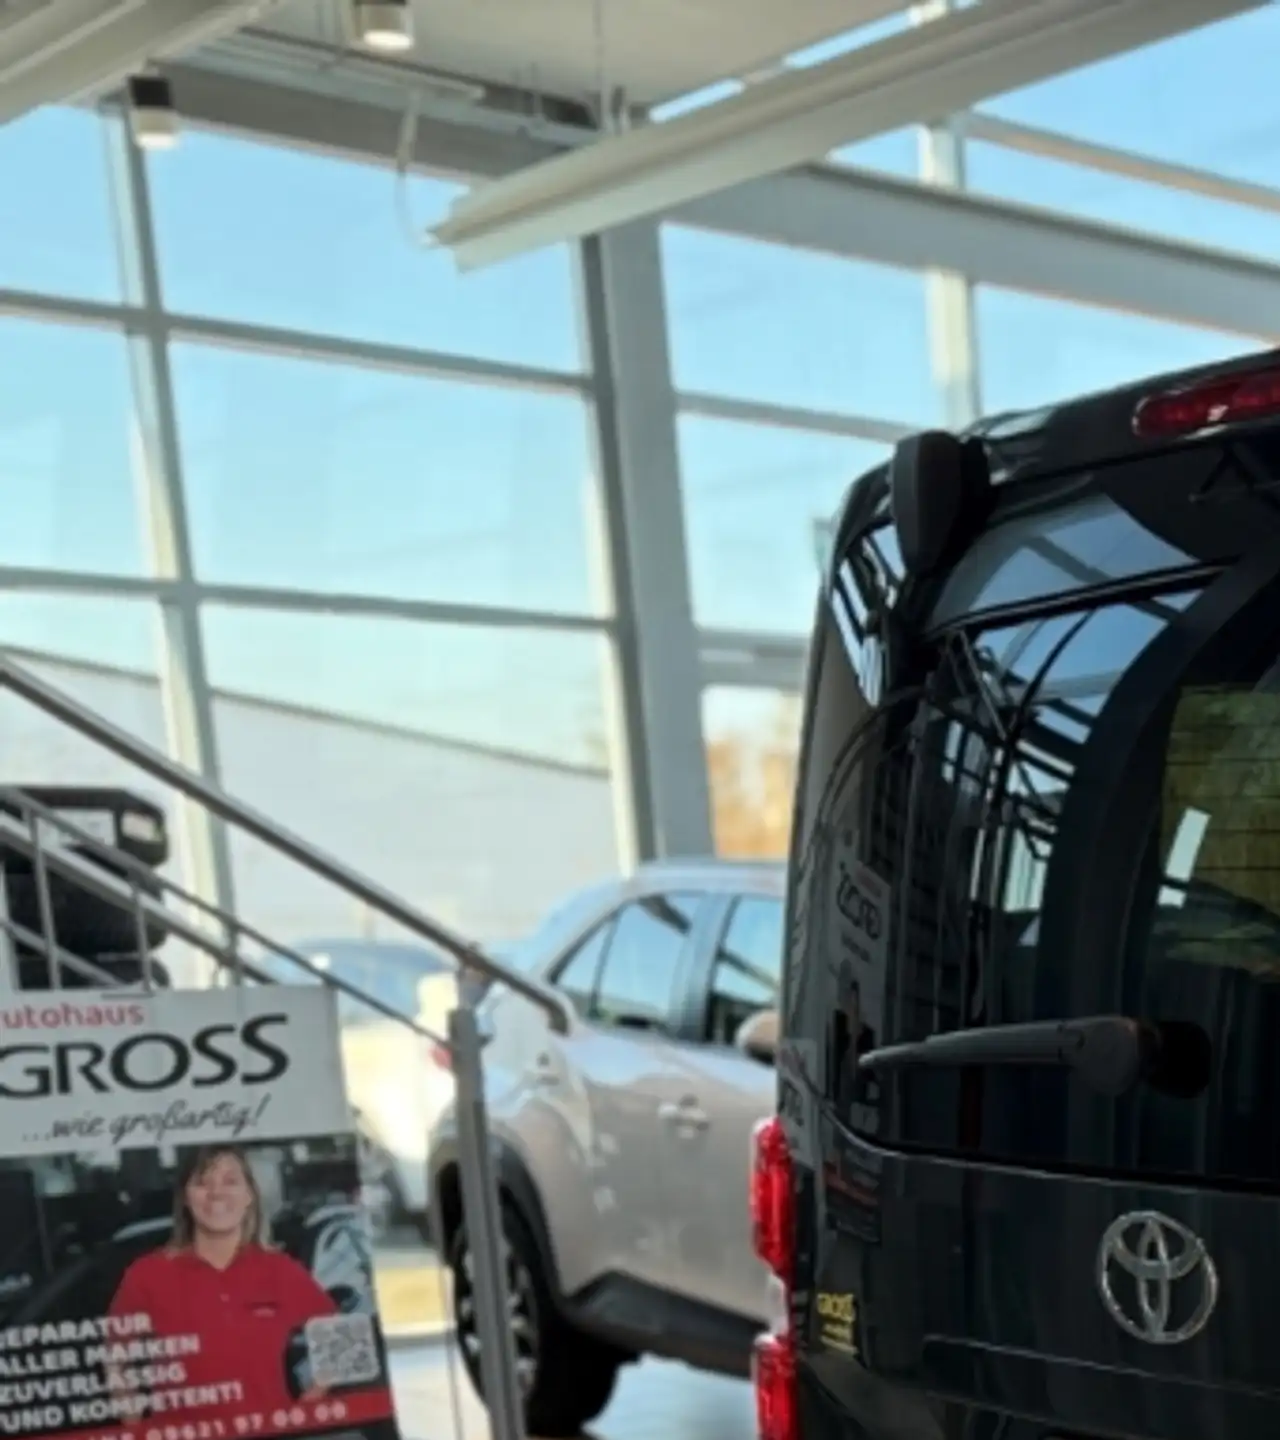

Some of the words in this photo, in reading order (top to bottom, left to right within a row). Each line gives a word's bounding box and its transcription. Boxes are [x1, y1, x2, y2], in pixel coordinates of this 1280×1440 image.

[0, 1002, 145, 1030] utohaus
[0, 1013, 290, 1098] GROSS
[107, 1092, 272, 1145] großartig!
[84, 1333, 201, 1366] MARKEN
[0, 1404, 64, 1433] UND
[69, 1380, 244, 1424] KOMPETENT!
